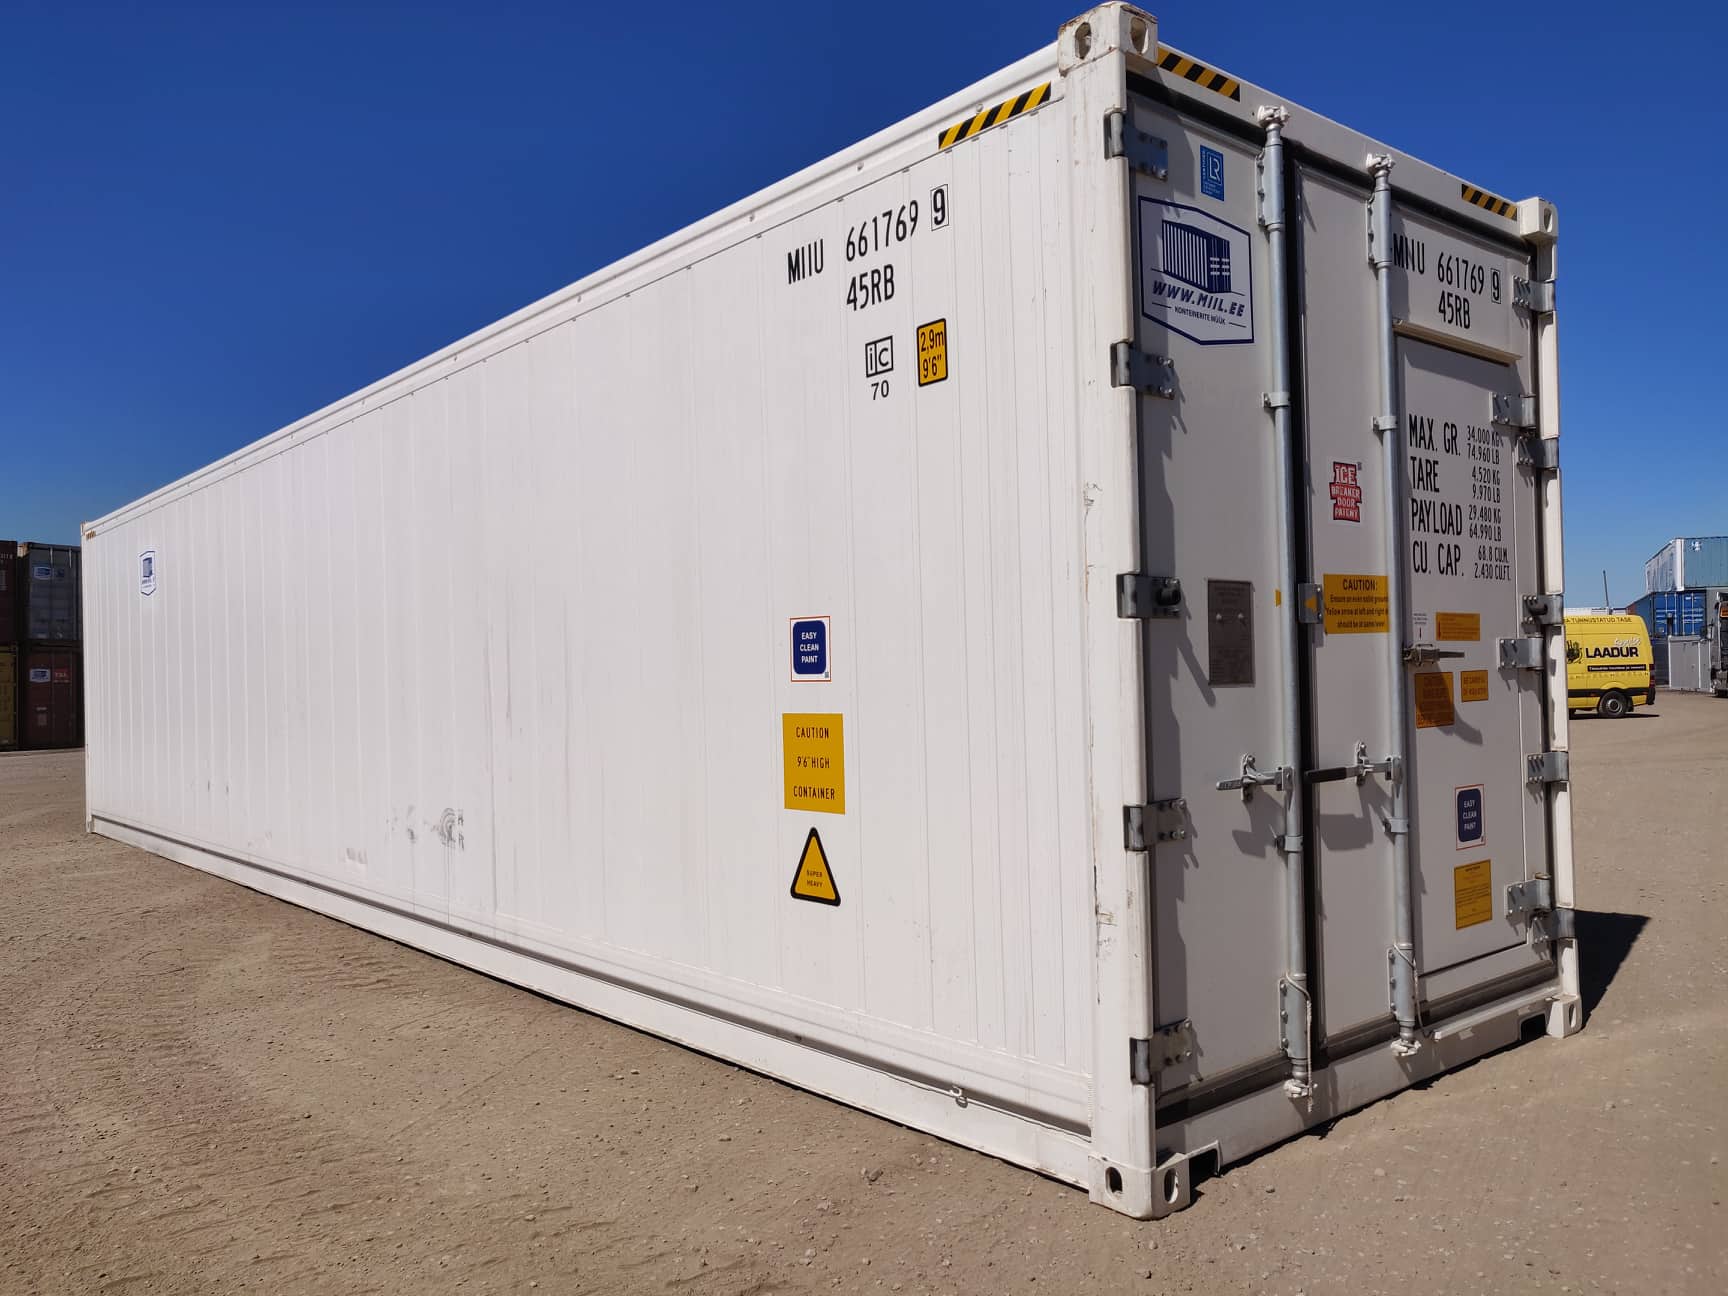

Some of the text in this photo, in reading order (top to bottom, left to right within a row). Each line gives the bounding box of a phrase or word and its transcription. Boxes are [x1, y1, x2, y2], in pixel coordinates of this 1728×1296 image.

[787, 188, 946, 285] MIIU 661769 9
[1437, 252, 1485, 295] 661769
[1492, 271, 1500, 301] 9
[847, 264, 895, 311] 45RB
[1152, 280, 1245, 317] WWW.MIIL.EE
[1438, 290, 1470, 329] 45RB
[920, 329, 944, 353] 2,9m
[871, 380, 889, 401] 70
[1409, 413, 1461, 457] MAX. GR.
[1467, 425, 1490, 445] 34.000
[1467, 443, 1500, 465] 74.960 LB
[1335, 465, 1356, 485] ICE
[1410, 456, 1440, 493] TARE
[1472, 465, 1500, 486] 4.520 KG
[1331, 486, 1360, 500] BREAKER
[1337, 497, 1356, 508] DOOR
[1472, 483, 1501, 504] 9.970 LB
[1335, 507, 1358, 519] PATENT
[1411, 498, 1463, 536] PAYLOAD
[1468, 504, 1502, 524] 29.480 KG
[1469, 523, 1502, 542] 64.990 LB
[1412, 540, 1465, 577] CU. CAP.
[801, 632, 817, 640] EASY
[800, 643, 819, 652] CLEAN
[1585, 646, 1639, 658] LAADUR
[801, 655, 818, 664] PAINT
[796, 726, 829, 739] CAUTION
[811, 756, 830, 769] HIGH
[793, 785, 835, 801] CONTAINER
[1463, 799, 1475, 808] EASY
[1462, 811, 1477, 819] CLEAN
[1463, 822, 1477, 830] PAINT
[806, 870, 823, 878] SUPER
